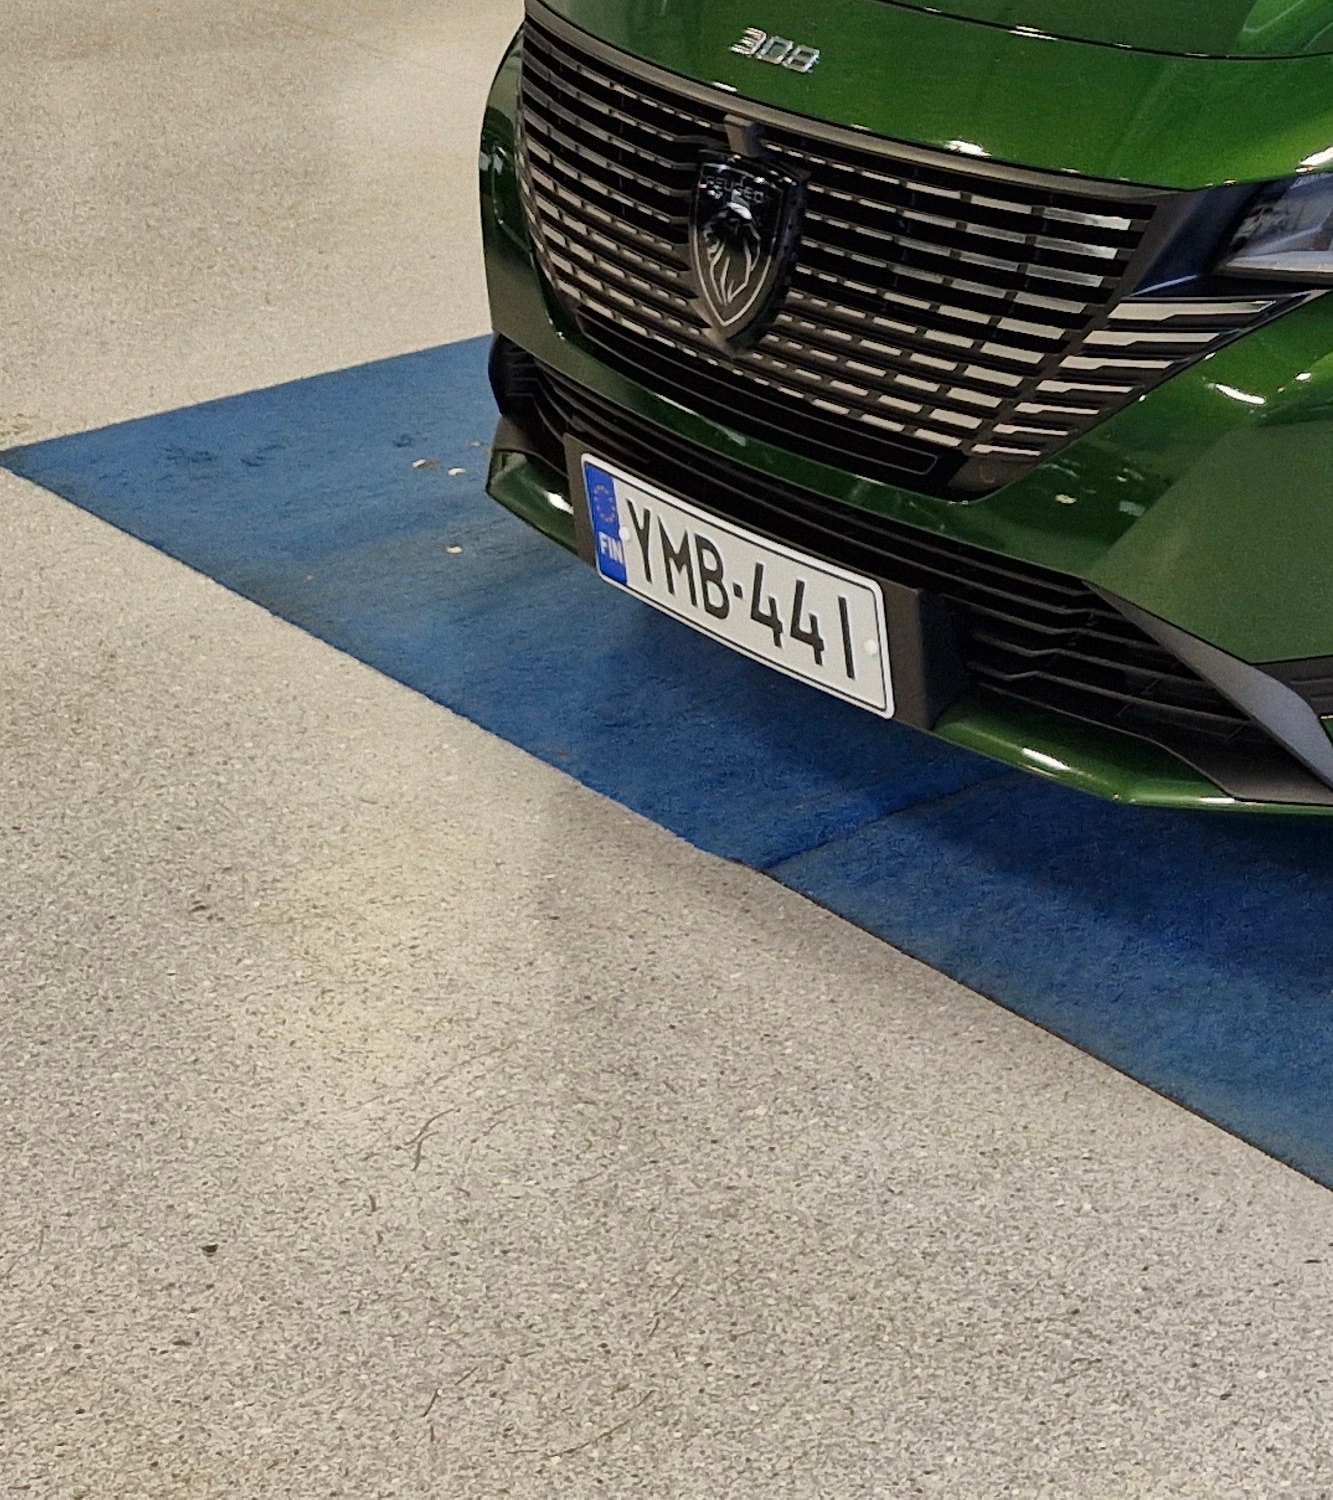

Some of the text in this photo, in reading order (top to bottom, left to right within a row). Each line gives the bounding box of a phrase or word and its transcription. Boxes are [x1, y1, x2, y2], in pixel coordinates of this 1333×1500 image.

[728, 27, 820, 73] 308
[599, 531, 624, 565] FIN
[626, 497, 856, 681] YMB-441
